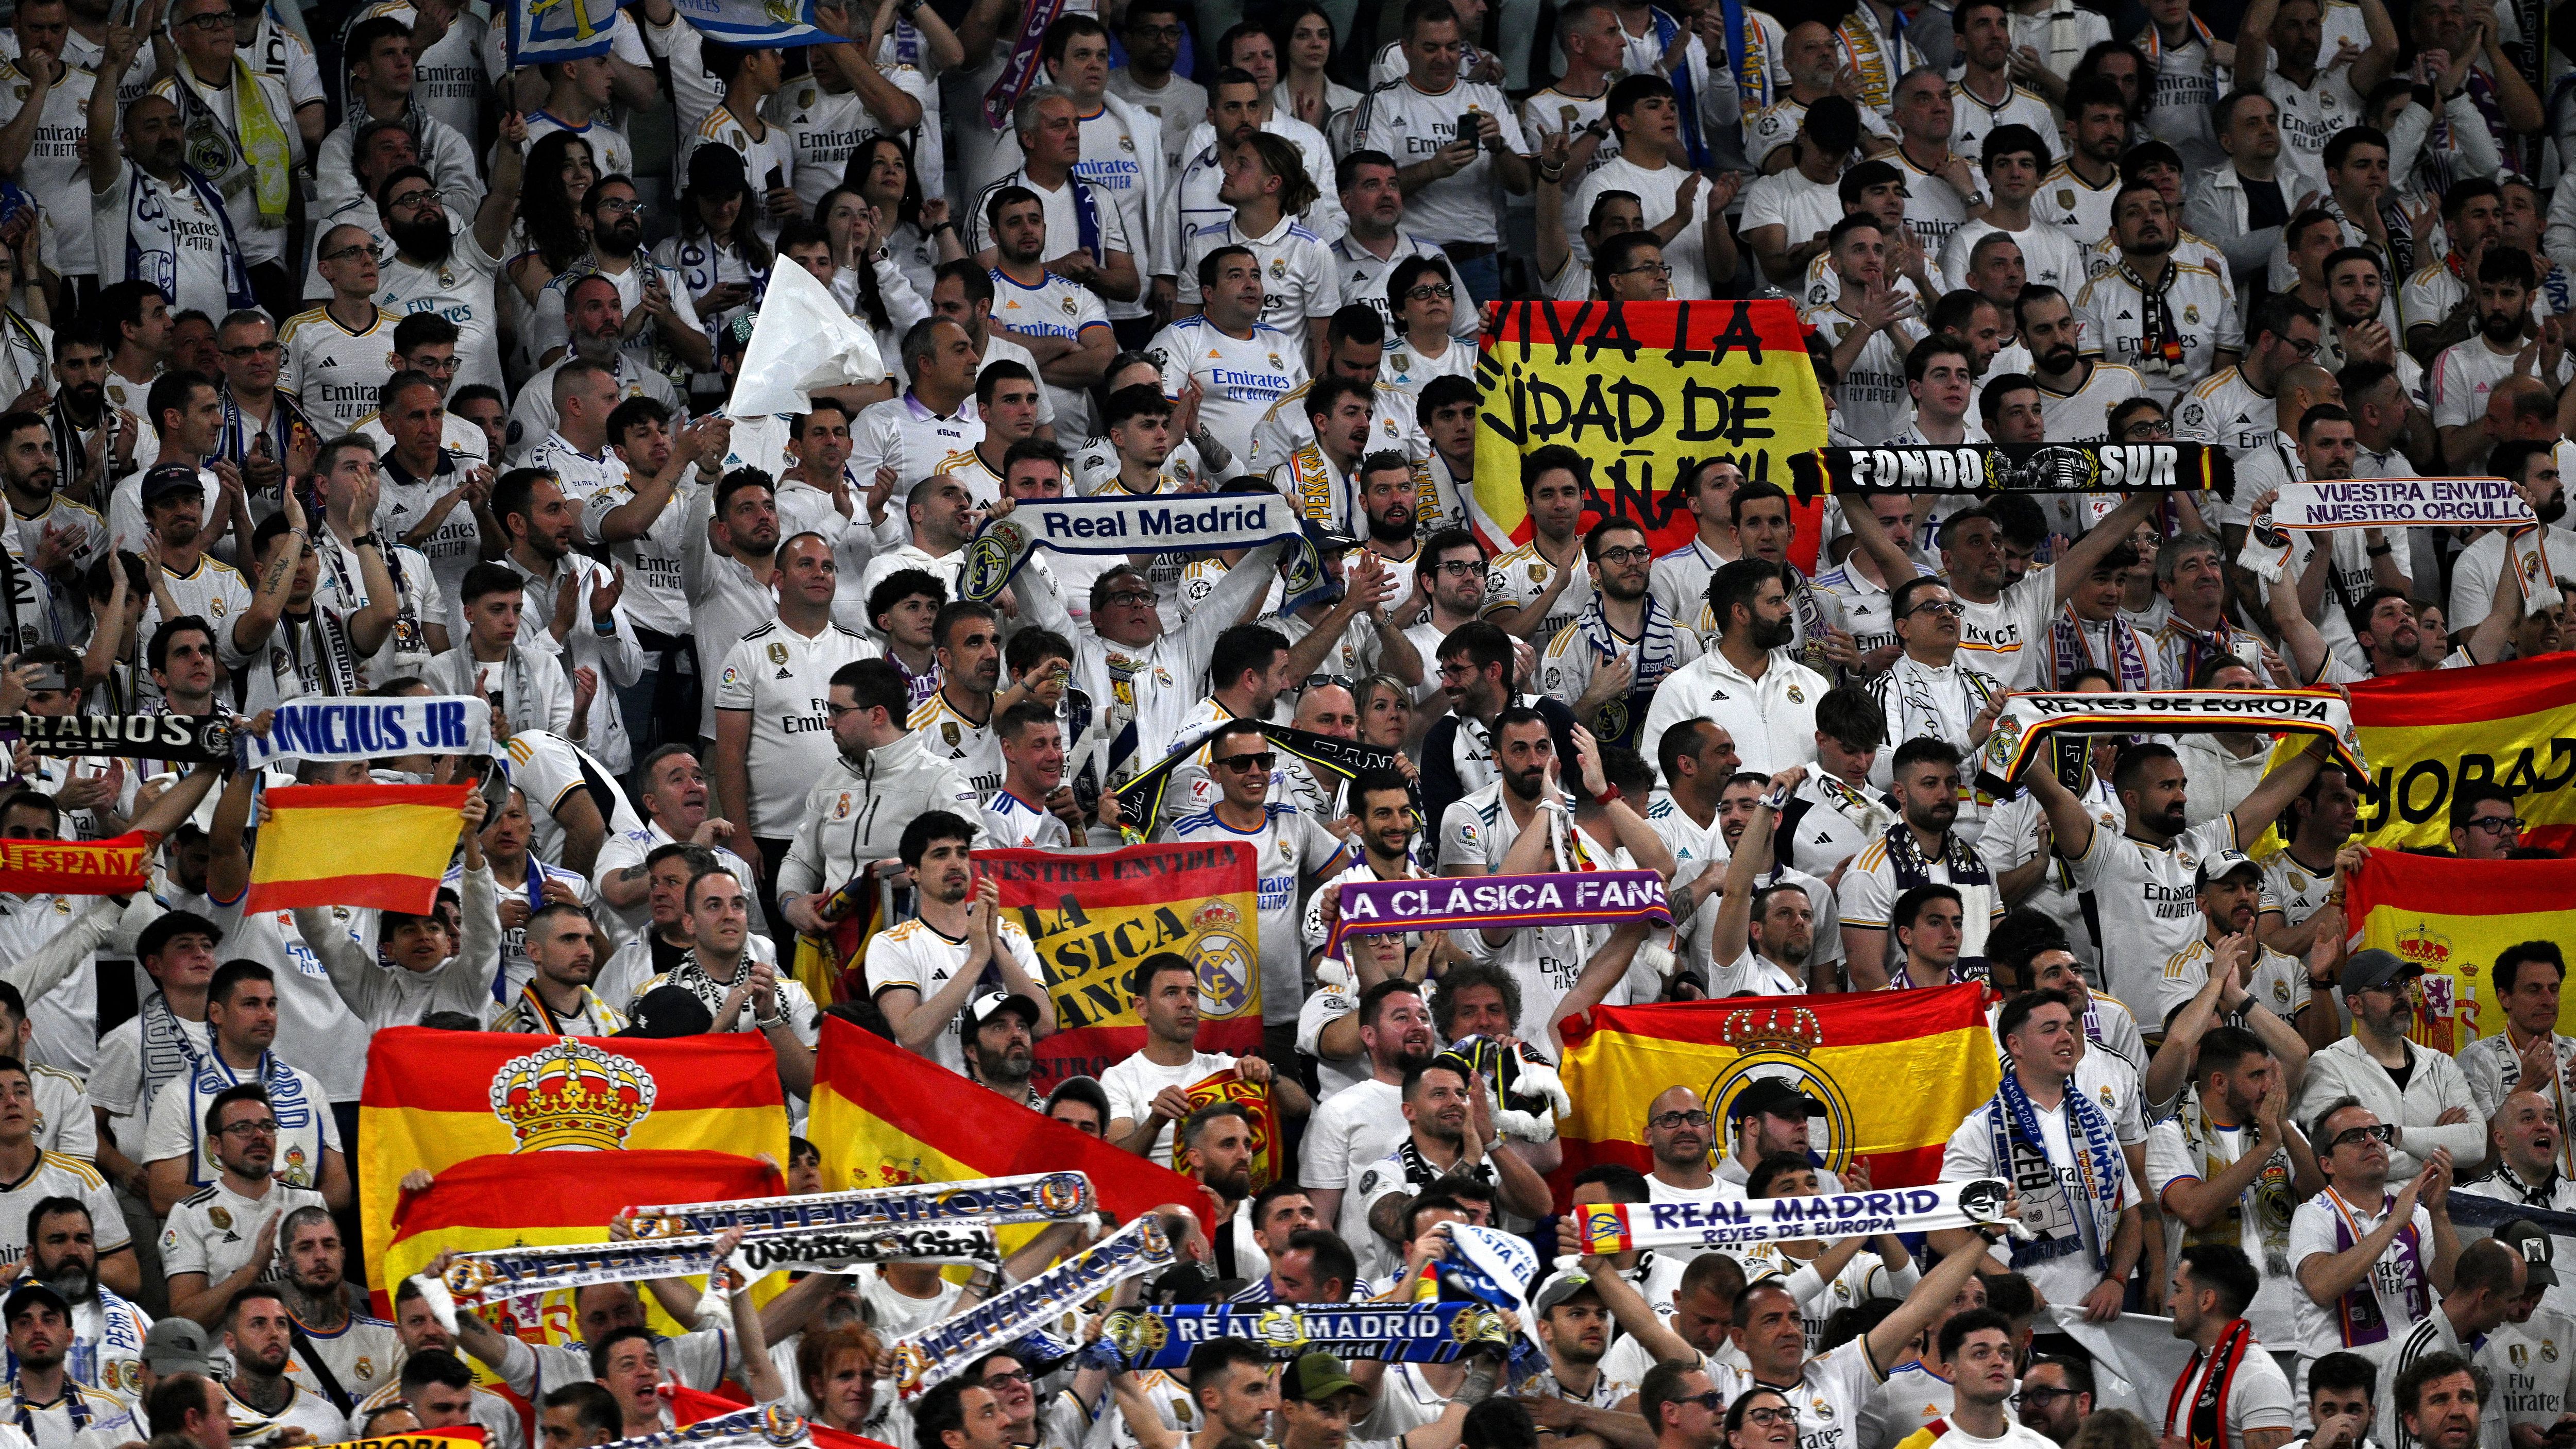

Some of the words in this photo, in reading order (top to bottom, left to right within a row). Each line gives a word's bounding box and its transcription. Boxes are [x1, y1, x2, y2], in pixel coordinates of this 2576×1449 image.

[53, 143, 79, 157] BETT
[1074, 158, 1139, 175] mirates
[1665, 300, 1762, 368] LA
[1212, 368, 1290, 390] Emirates
[1228, 385, 1243, 399] FLY
[1246, 387, 1279, 402] BETTER
[1849, 388, 1864, 402] FLY
[1867, 388, 1896, 403] BETTER
[334, 403, 352, 418] FLY
[356, 402, 380, 418] BETT
[1676, 376, 1781, 447] DE
[937, 428, 962, 438] KELME
[1851, 448, 1985, 489] FONDO
[2101, 445, 2177, 487] SUR
[2313, 482, 2424, 502] VUESTRA
[1043, 511, 1127, 538] Real
[1139, 503, 1267, 536] Madrid
[2306, 503, 2418, 523] NUESTRO
[649, 573, 664, 588] FLY
[1640, 662, 1663, 673] DESDE
[2029, 696, 2136, 714] REYES
[2147, 697, 2191, 712] DE
[2200, 697, 2328, 721] EUROPA
[1113, 845, 1237, 880] ENVIDIA
[1259, 876, 1295, 894] rates
[1392, 880, 1562, 916] CLÁSICA
[1018, 892, 1092, 943] LA
[2155, 904, 2170, 917] FLY
[1055, 968, 1137, 1032] ANS
[1032, 1056, 1112, 1080] STRO
[2018, 1109, 2039, 1135] 2022
[686, 1186, 1024, 1236] VETERANOS
[1650, 1200, 1751, 1230] REAL
[1772, 1188, 1940, 1223] MADRID
[1704, 1224, 1768, 1245] REYES
[1778, 1222, 1805, 1238] DE
[1815, 1216, 1896, 1236] EUROPA
[1469, 1226, 1513, 1265] ASTA
[1651, 1302, 1675, 1311] DOCKER
[1176, 1317, 1261, 1341] REAL
[1302, 1314, 1439, 1339] MADRID
[2509, 1372, 2534, 1391] Fly
